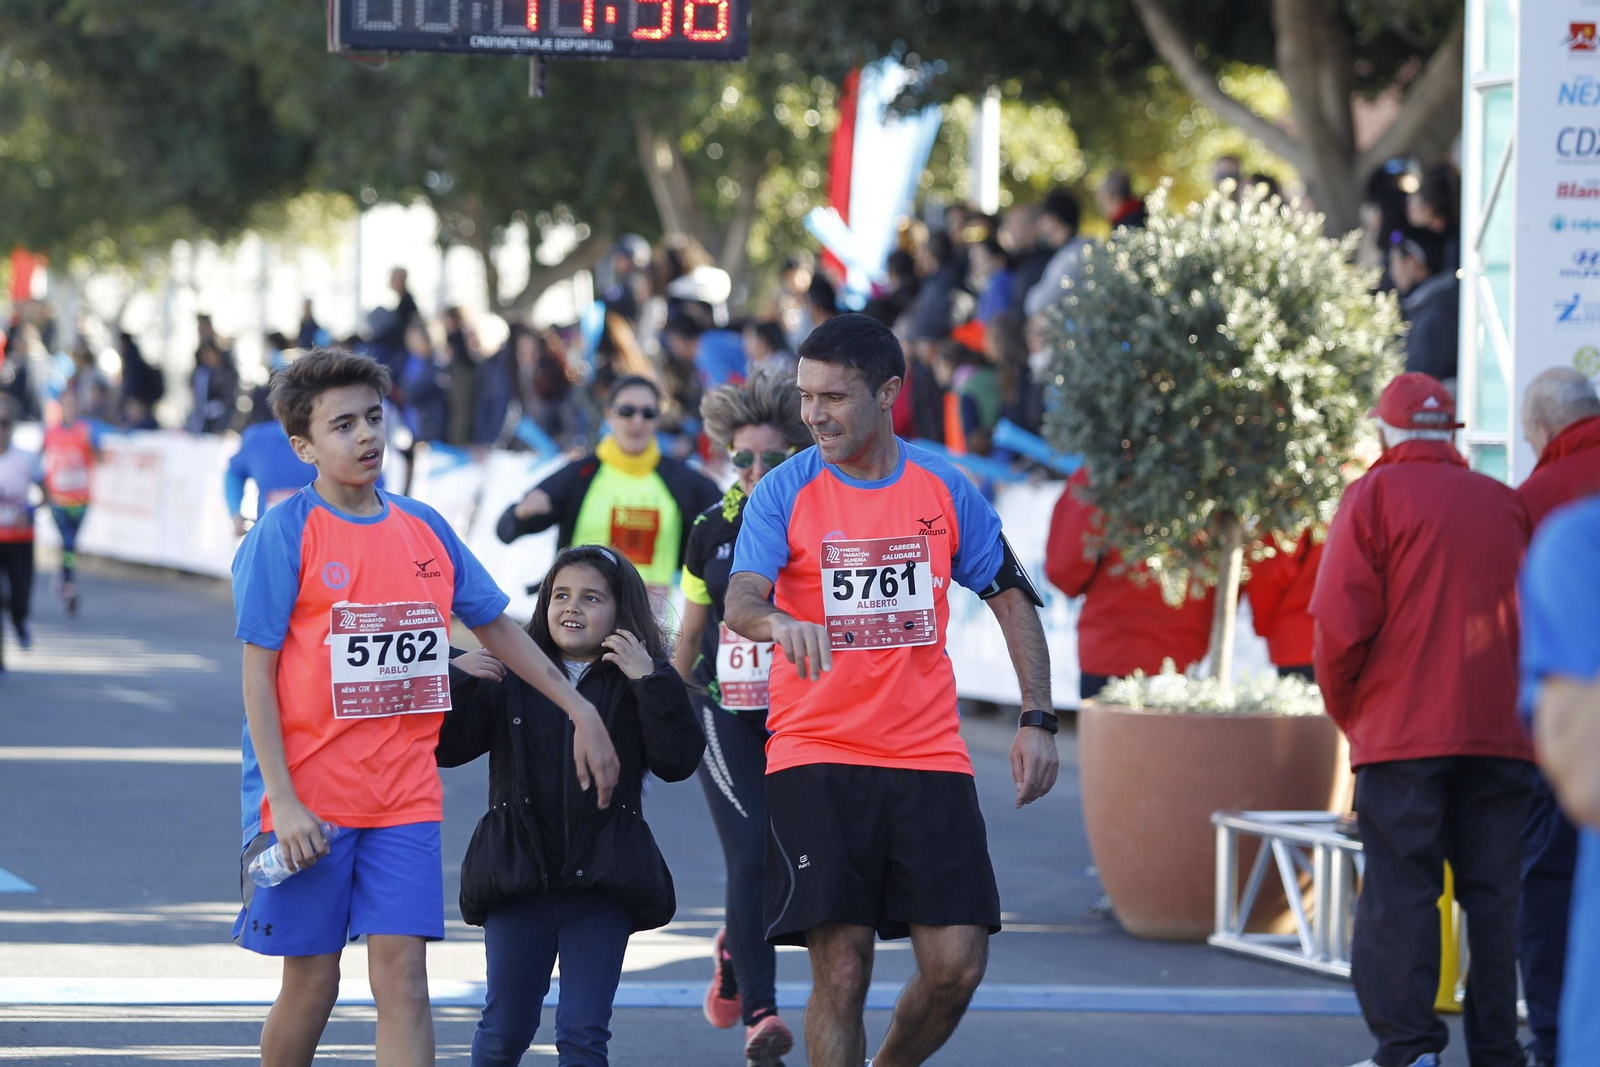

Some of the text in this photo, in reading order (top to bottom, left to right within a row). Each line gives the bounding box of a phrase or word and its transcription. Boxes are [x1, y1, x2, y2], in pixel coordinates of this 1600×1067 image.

[554, 37, 614, 52] DEPORTIVO
[1556, 126, 1600, 157] CD
[889, 543, 921, 552] CARRERA
[882, 551, 922, 561] SALUDABLE
[832, 566, 916, 600] 5761
[856, 599, 897, 609] ALBERTO
[399, 616, 439, 627] SALUDABLE
[346, 630, 438, 667] 5762
[379, 665, 408, 675] PABLO
